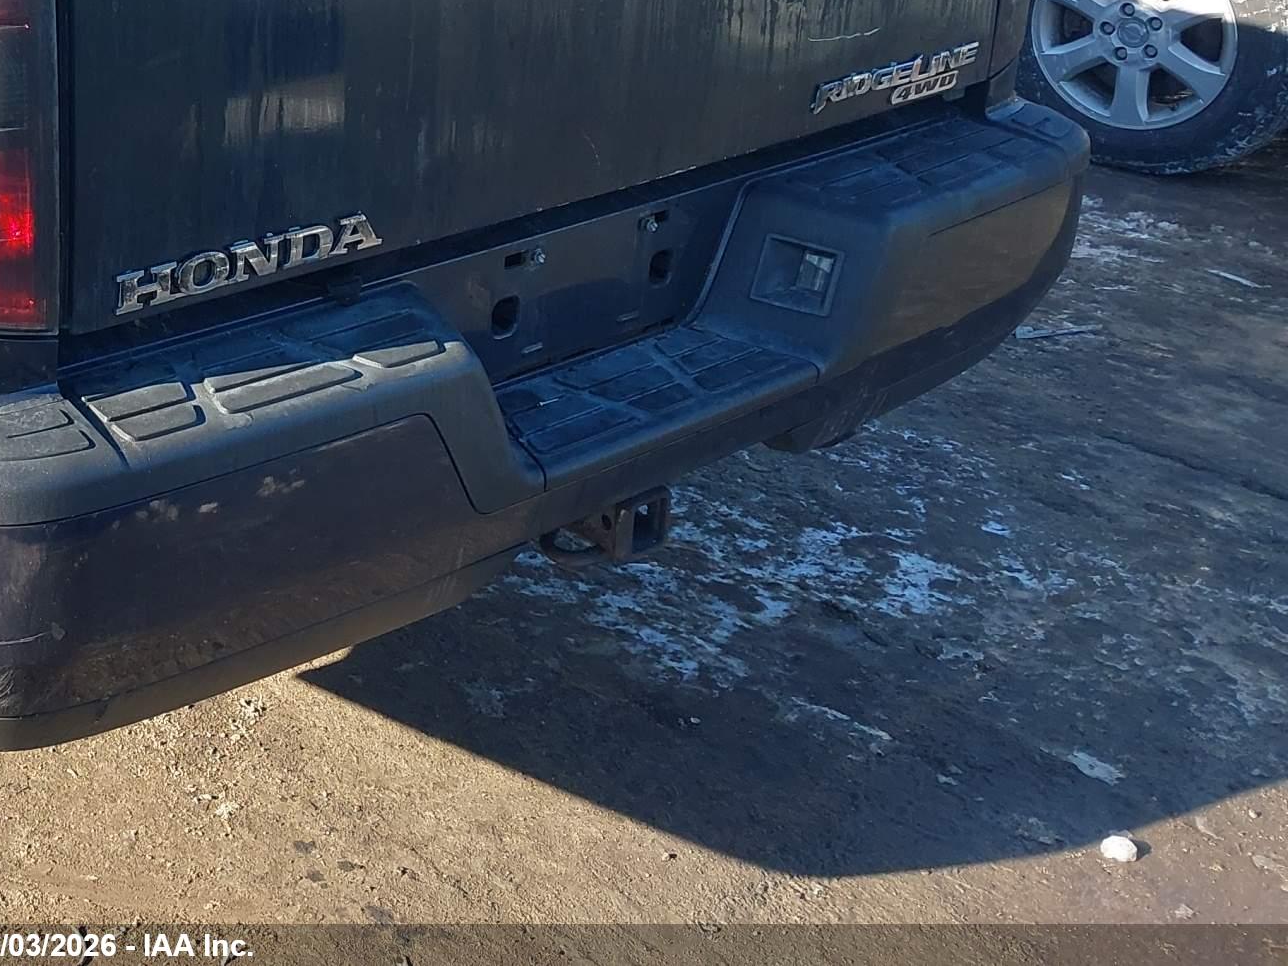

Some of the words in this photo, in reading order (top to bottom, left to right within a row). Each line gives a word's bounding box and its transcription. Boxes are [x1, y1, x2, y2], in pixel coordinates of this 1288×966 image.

[810, 41, 980, 115] RIDGELINE
[895, 72, 958, 102] 4WD
[113, 210, 383, 316] HONDA
